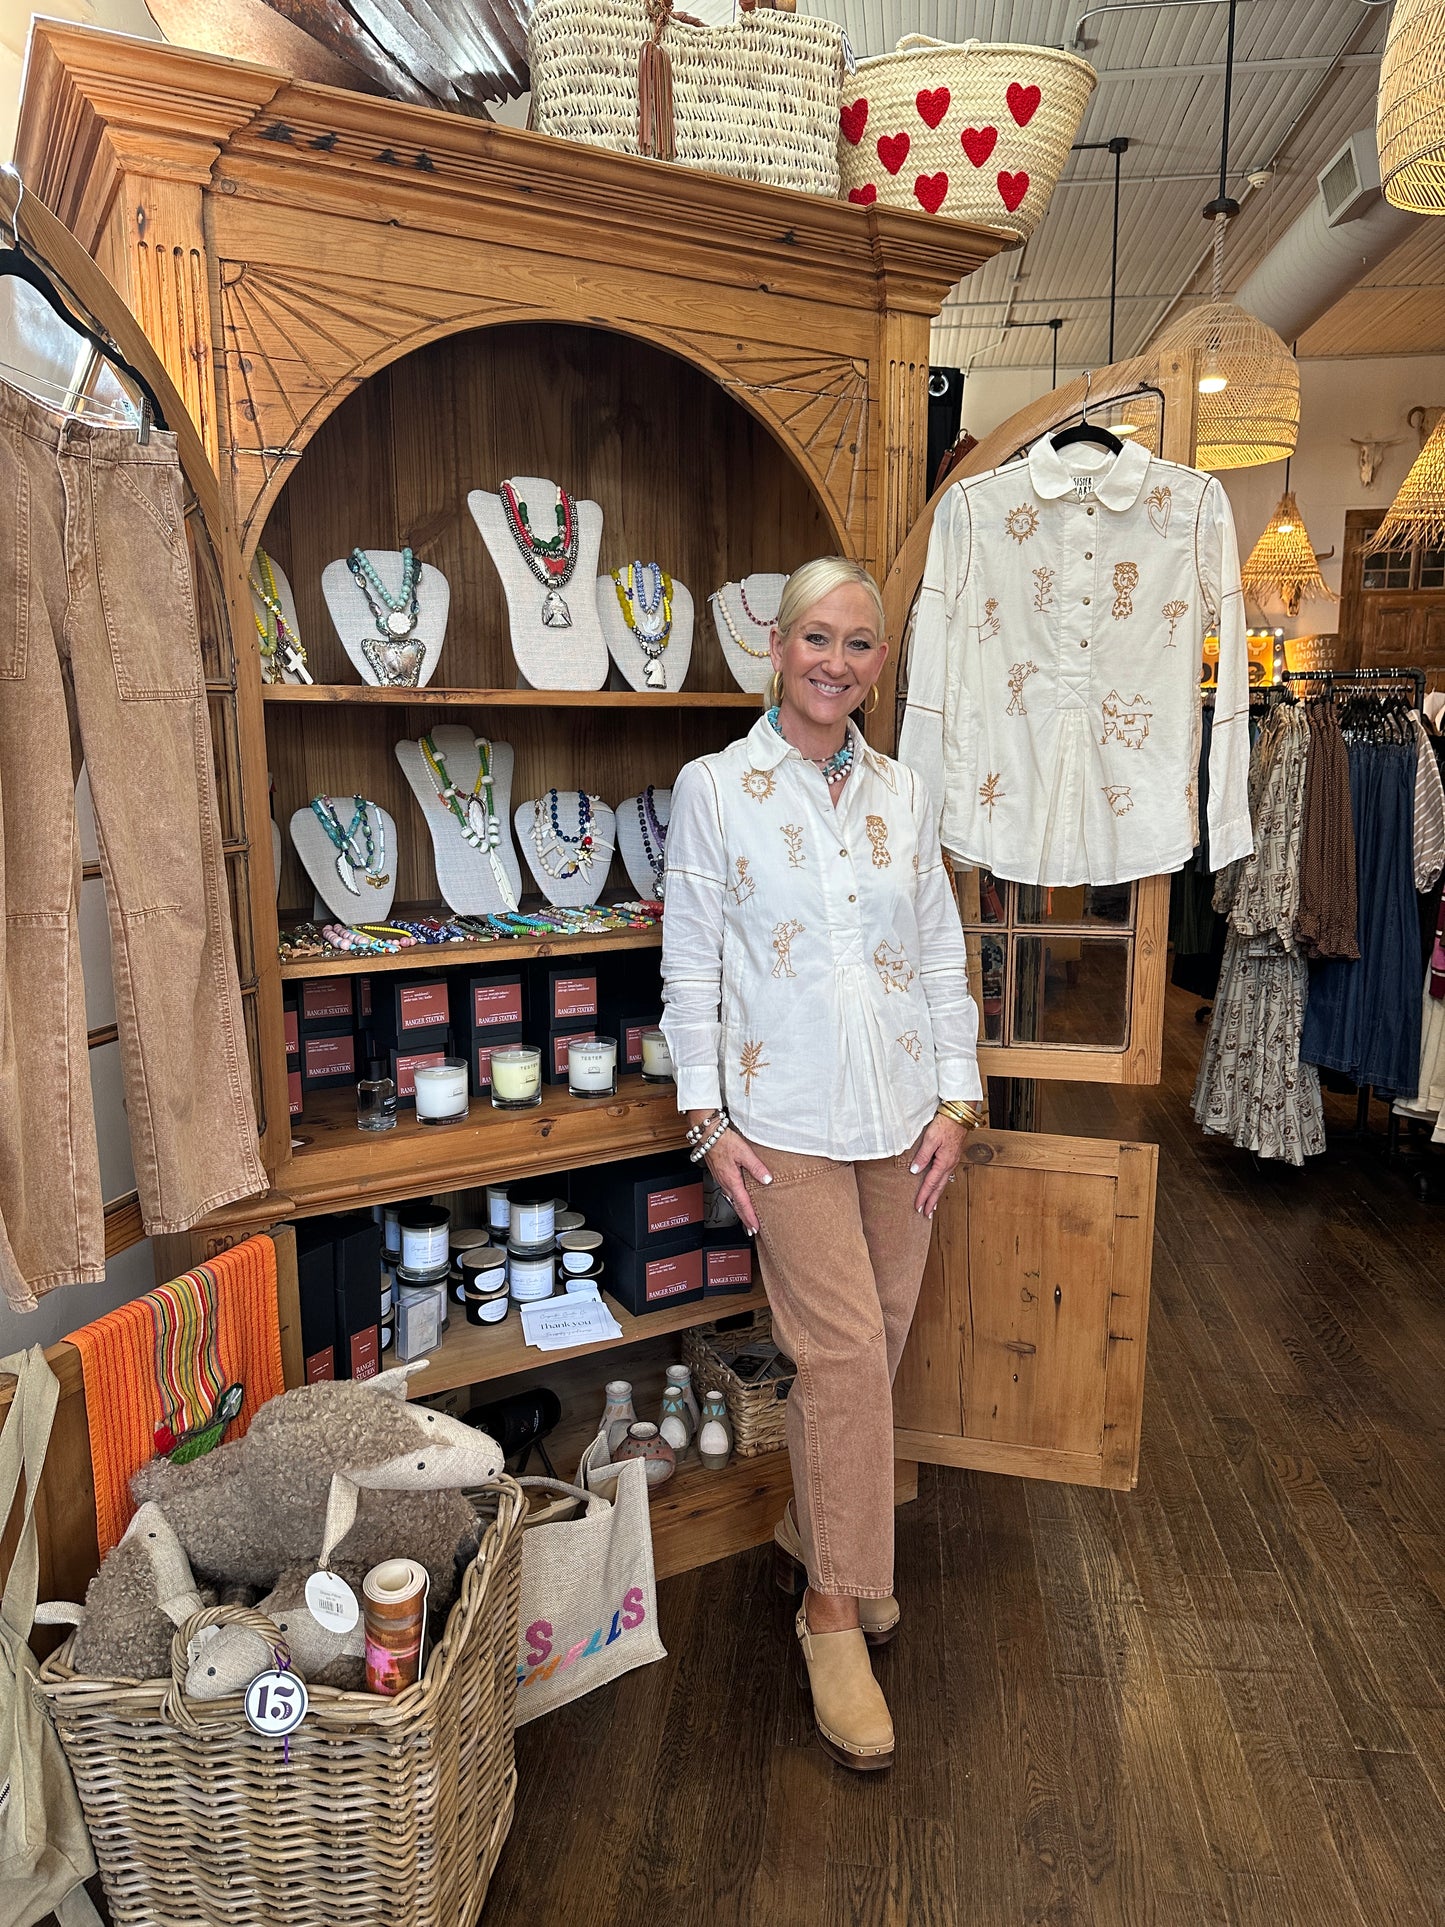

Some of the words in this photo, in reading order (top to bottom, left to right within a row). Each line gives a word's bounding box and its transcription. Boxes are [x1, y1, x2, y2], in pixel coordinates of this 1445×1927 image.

[307, 1008, 329, 1017] RANGER
[329, 1007, 350, 1015] STATION
[558, 1007, 576, 1015] RANGER
[404, 1019, 424, 1027] RANGER
[425, 1015, 445, 1024] STATION
[478, 1016, 498, 1024] RANGER
[309, 1067, 329, 1075] RANGER
[331, 1064, 351, 1073] STATION
[650, 1220, 670, 1230] RANGER
[670, 1216, 690, 1225] STATION
[648, 1288, 668, 1299] RANGER
[668, 1284, 687, 1293] STATION
[541, 1320, 570, 1330] Thank
[572, 1320, 592, 1329] you
[355, 1359, 375, 1374] RANGER
[256, 1685, 295, 1720] 15
